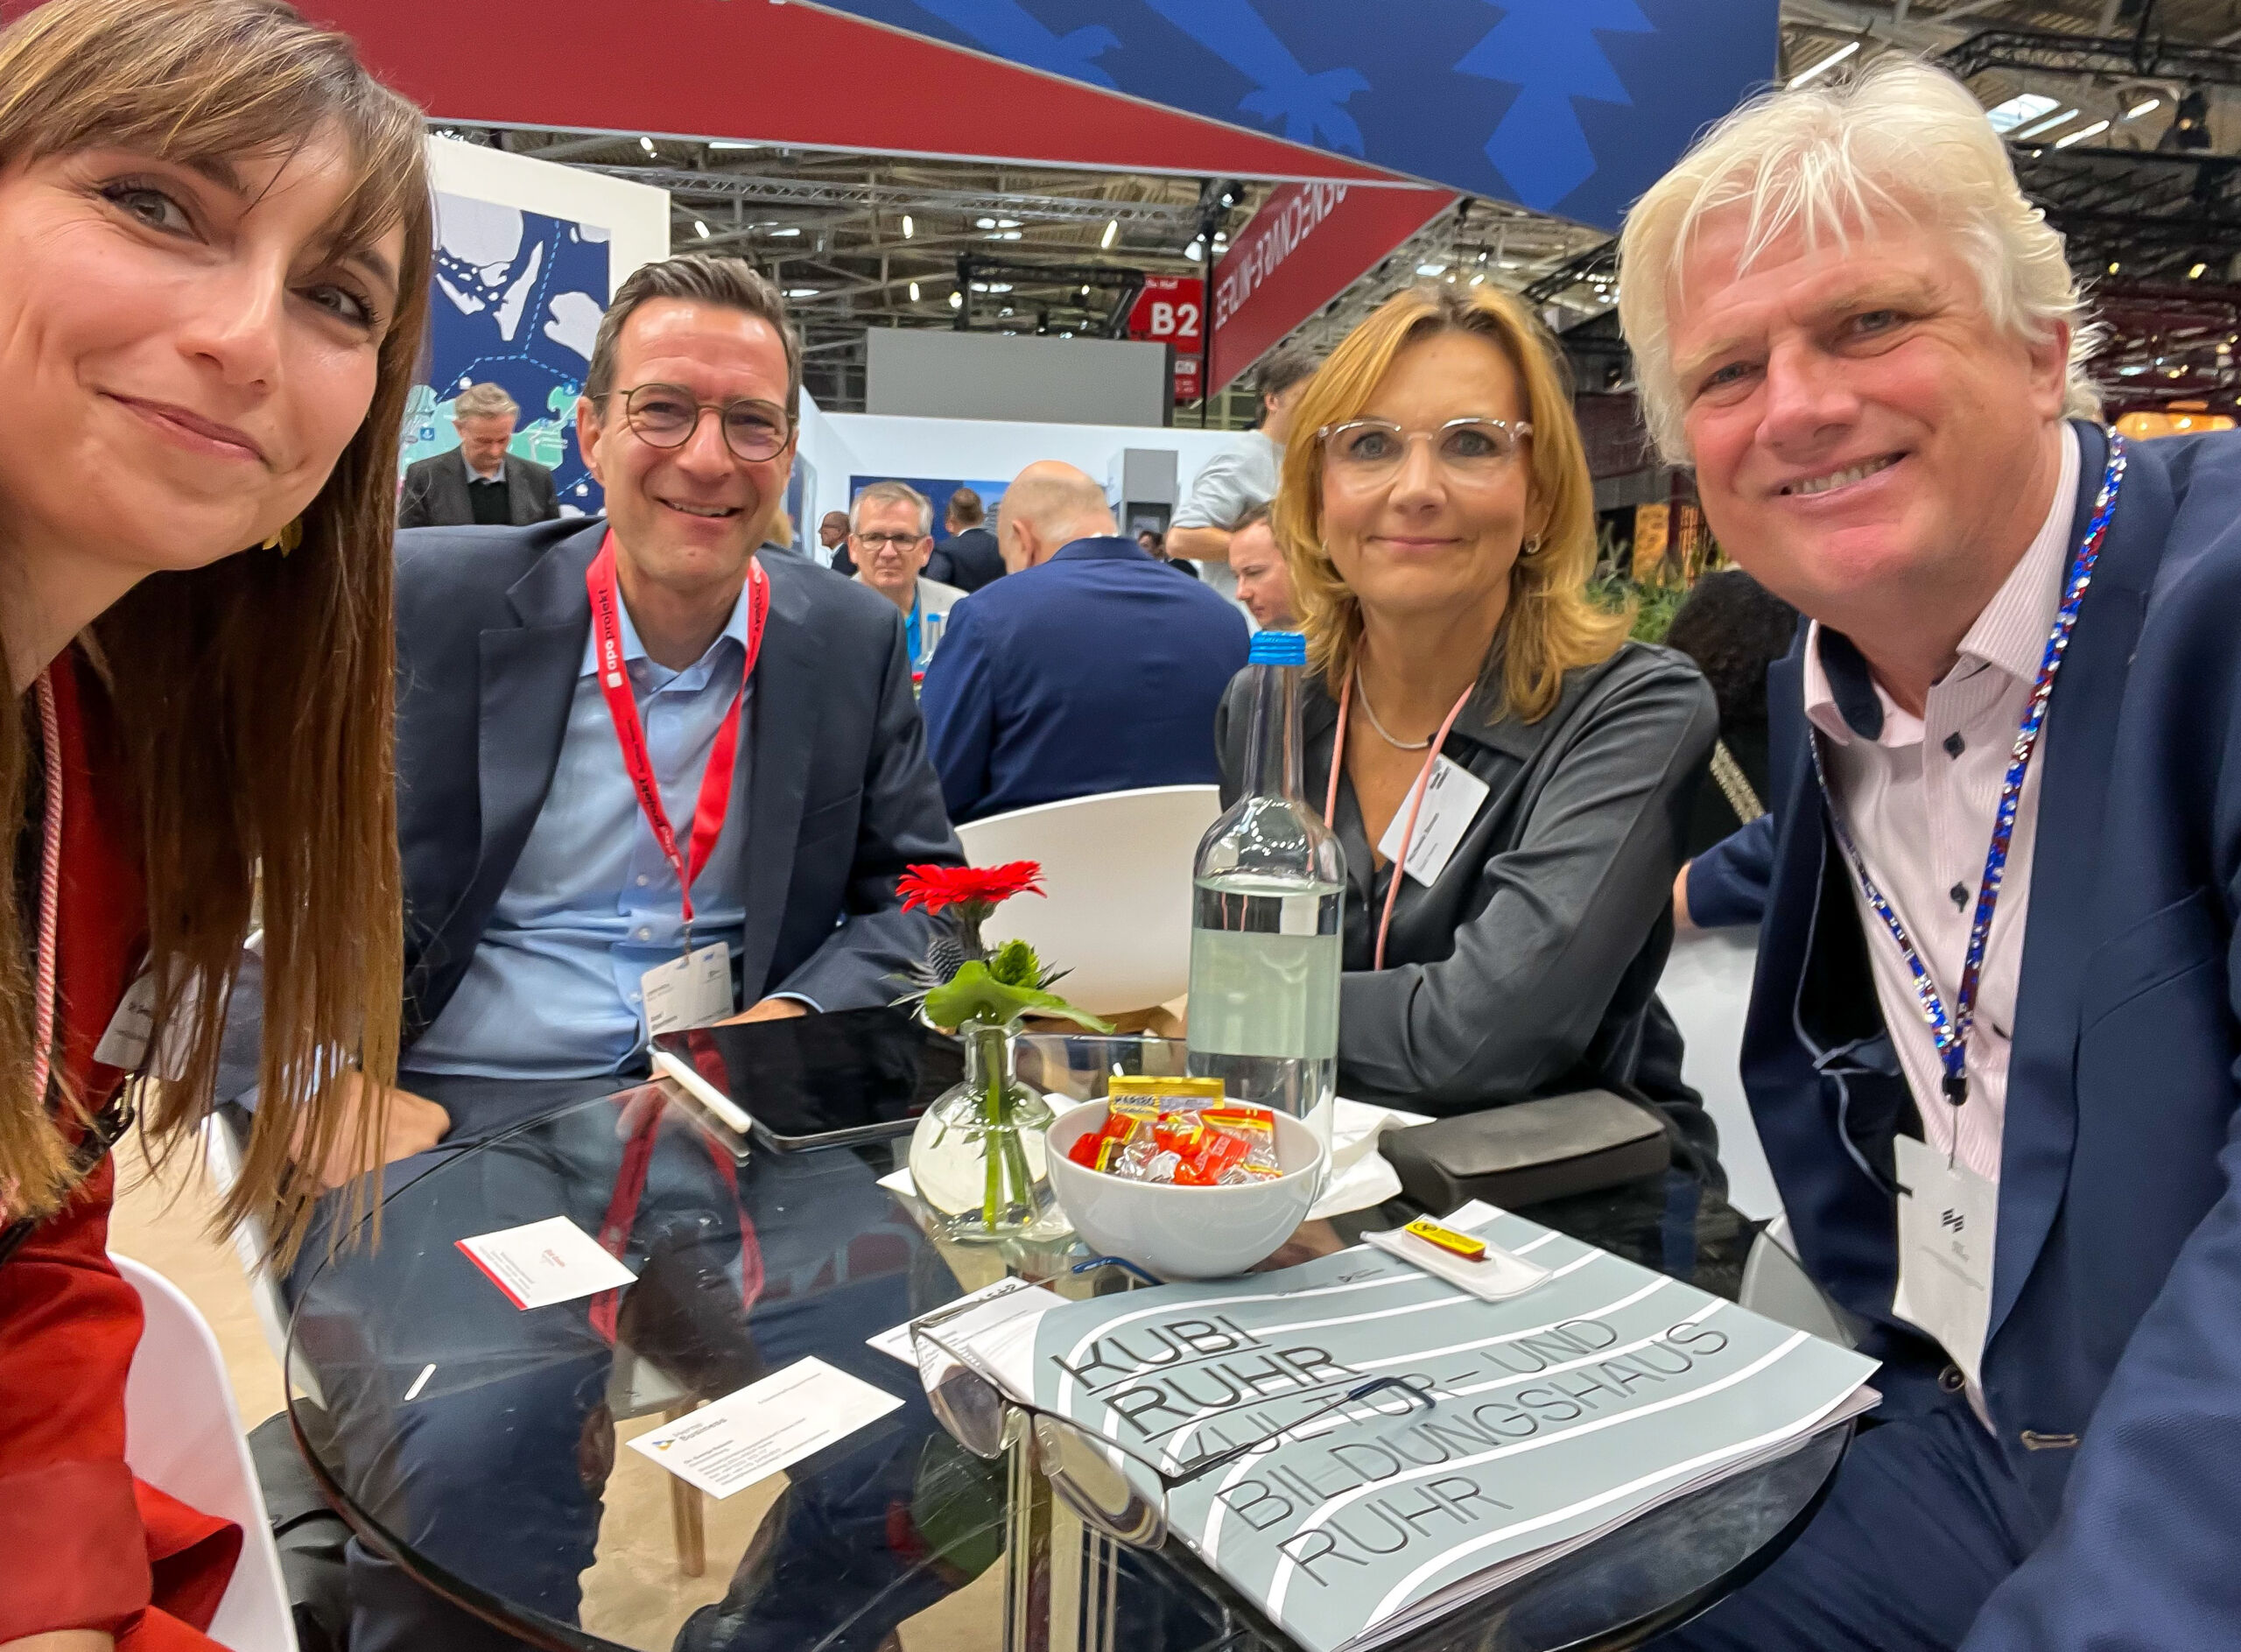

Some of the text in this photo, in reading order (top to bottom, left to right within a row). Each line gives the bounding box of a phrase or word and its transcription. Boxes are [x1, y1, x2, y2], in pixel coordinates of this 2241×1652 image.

[1151, 300, 1199, 337] B2
[597, 587, 620, 671] apoprojekt
[1049, 1314, 1263, 1390] KUBI
[1479, 1318, 1619, 1374] UND
[1101, 1346, 1363, 1438] RUHR
[1213, 1321, 1730, 1532] BILDUNGSHAUS
[1275, 1475, 1514, 1587] RUHR
